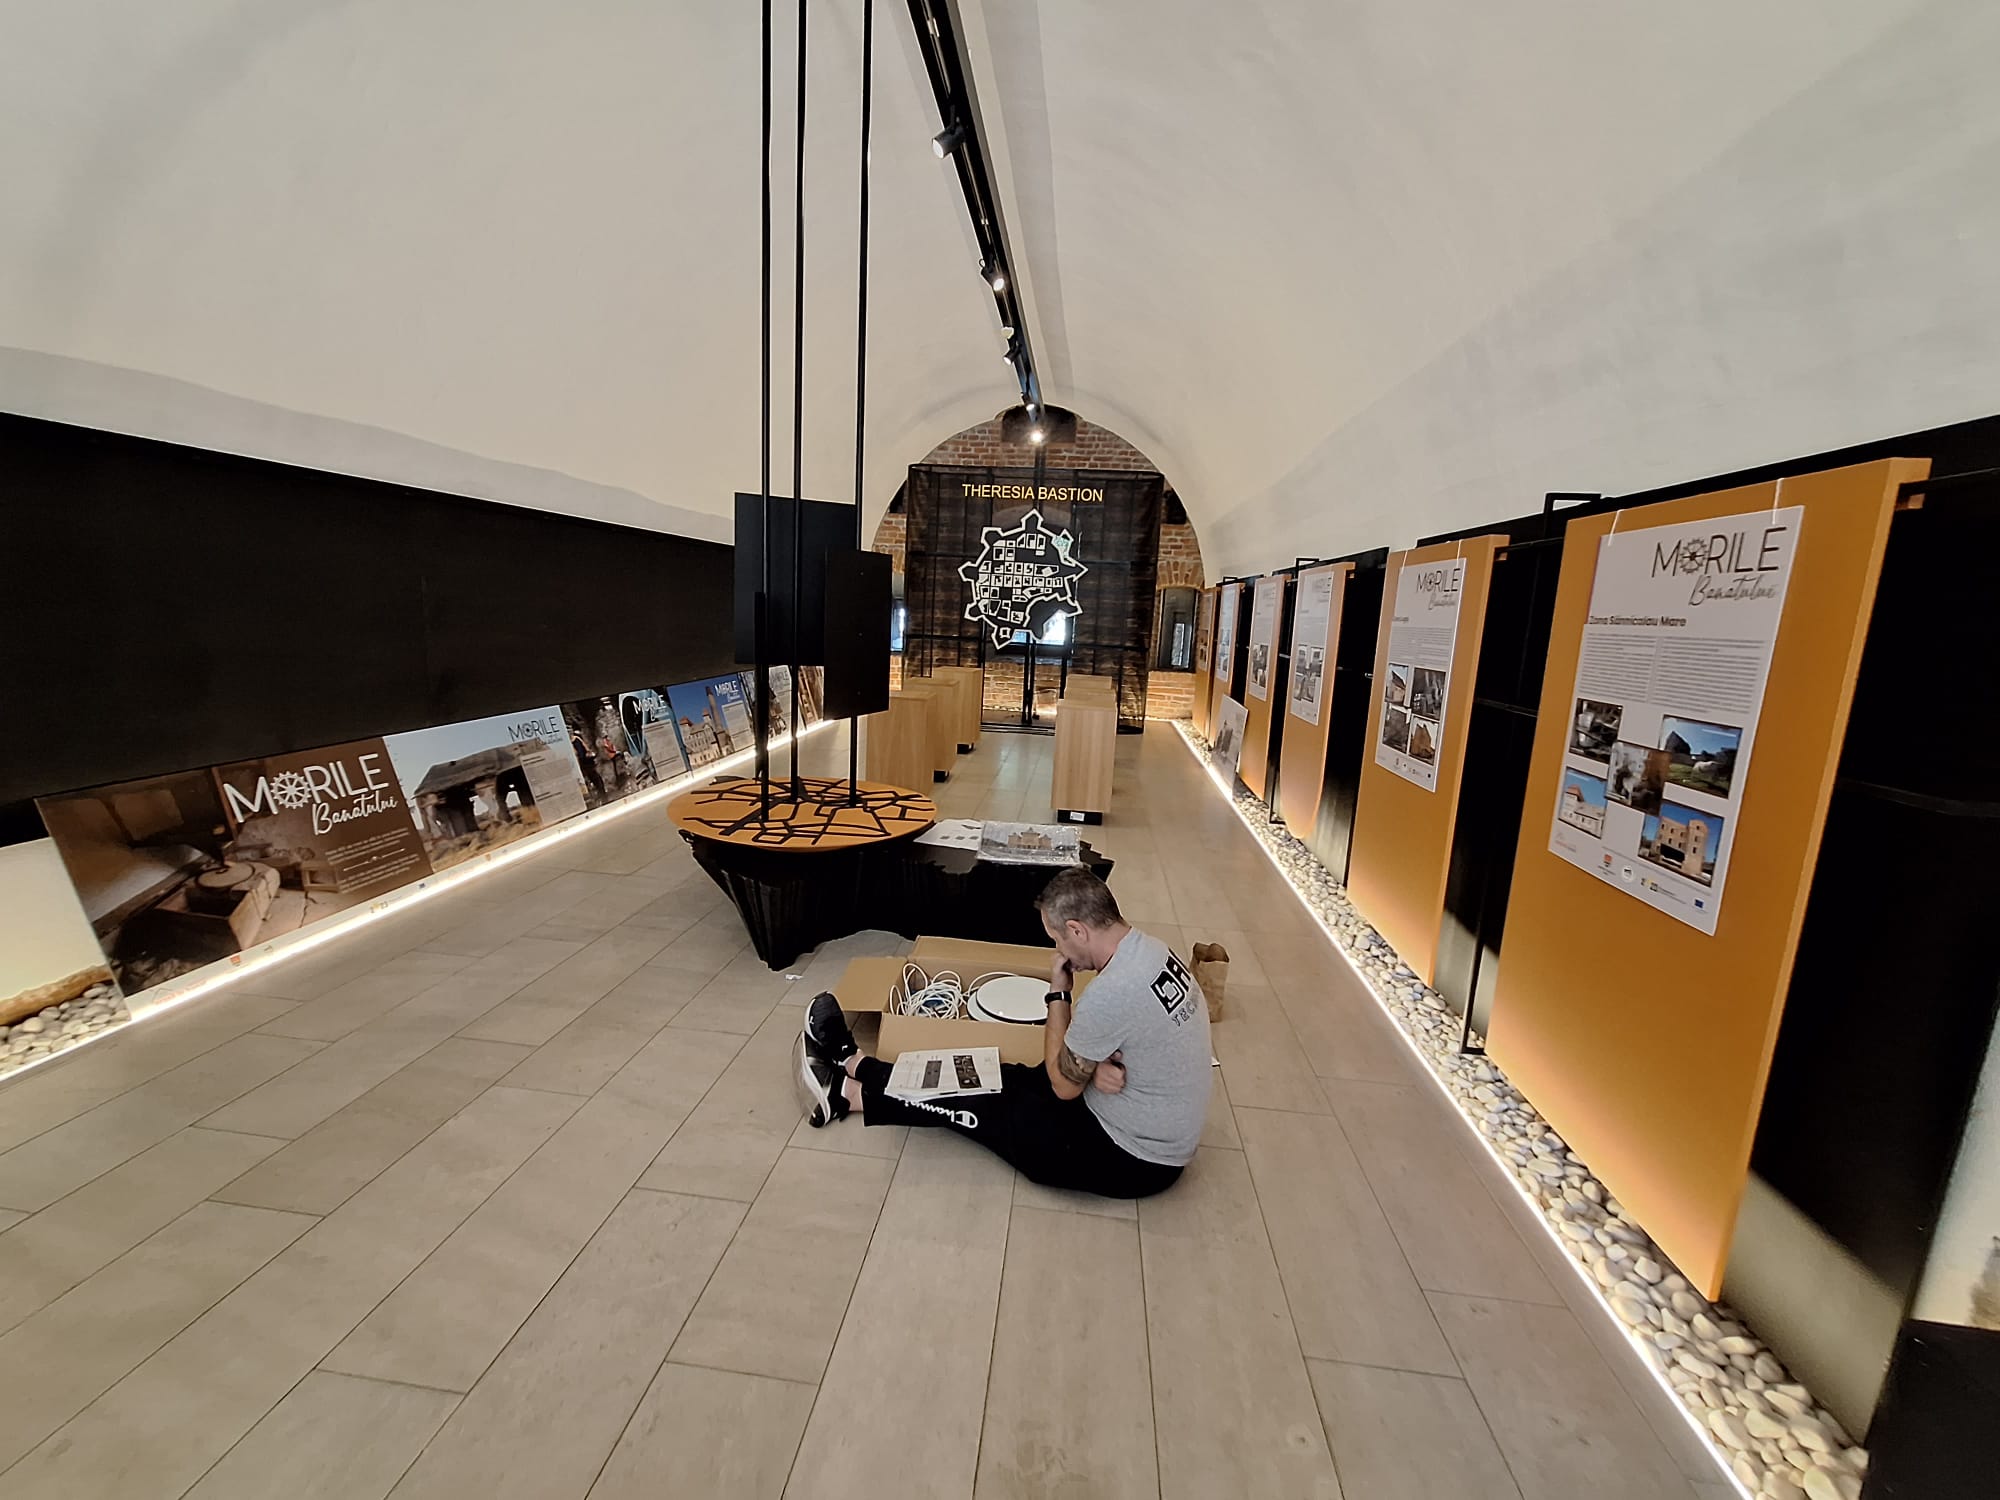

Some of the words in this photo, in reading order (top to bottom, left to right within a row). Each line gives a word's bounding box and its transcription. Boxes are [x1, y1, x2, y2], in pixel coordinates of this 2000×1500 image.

[962, 483, 1035, 500] THERESIA
[1037, 486, 1104, 502] BASTION
[1651, 526, 1788, 578] MORILE
[223, 753, 389, 824] MORILE
[311, 790, 399, 835] Banatului
[898, 1099, 978, 1128] Champi
